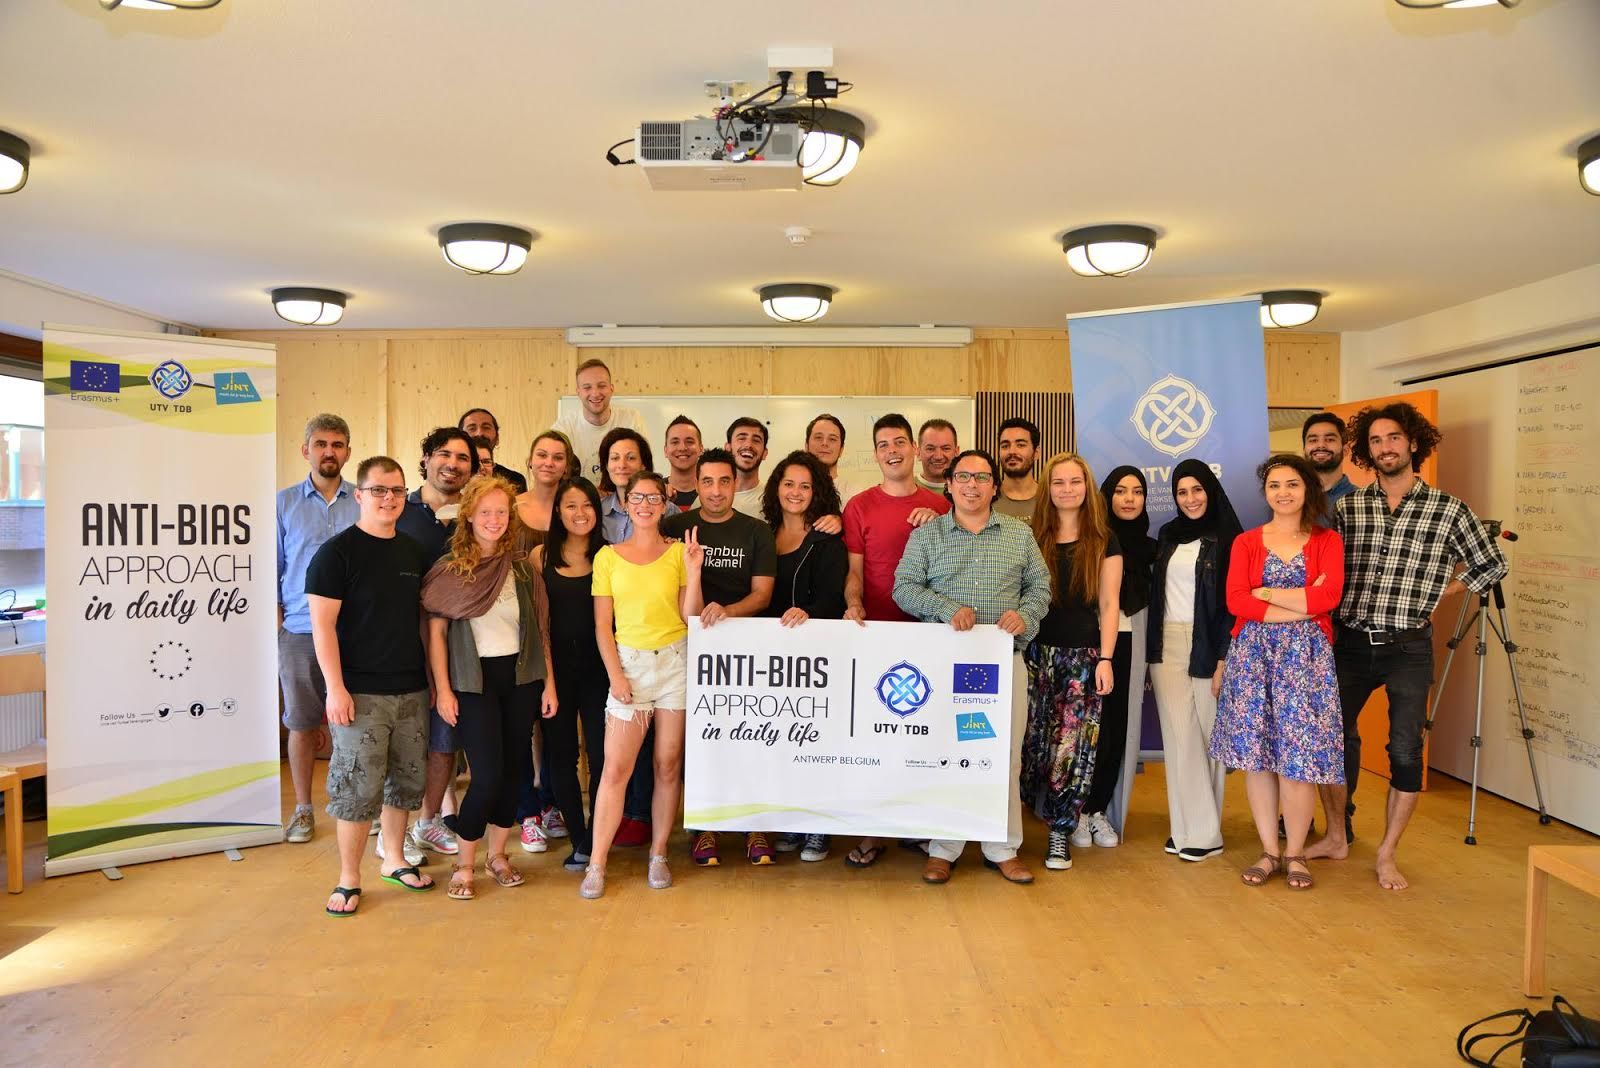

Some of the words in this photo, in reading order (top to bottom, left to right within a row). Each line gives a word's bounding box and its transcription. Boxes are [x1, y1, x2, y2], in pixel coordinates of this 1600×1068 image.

[71, 392, 119, 403] Erasmus+
[150, 403, 169, 412] UTV
[173, 404, 192, 413] TDB
[82, 503, 251, 546] ANTI-BIAS
[79, 554, 252, 586] APPROACH
[84, 595, 116, 621] in
[126, 589, 198, 625] daily
[207, 587, 250, 622] life
[697, 654, 828, 688] ANTI-BIAS
[693, 694, 828, 719] APPROACH
[953, 696, 998, 705] Erasmus+
[100, 713, 125, 721] Follow
[702, 722, 722, 740] in
[729, 721, 781, 747] daily
[787, 722, 820, 747] life
[874, 723, 898, 734] UTV
[904, 724, 929, 735] TDB
[793, 755, 838, 764] ANTWERP
[839, 756, 881, 766] BELGIUM
